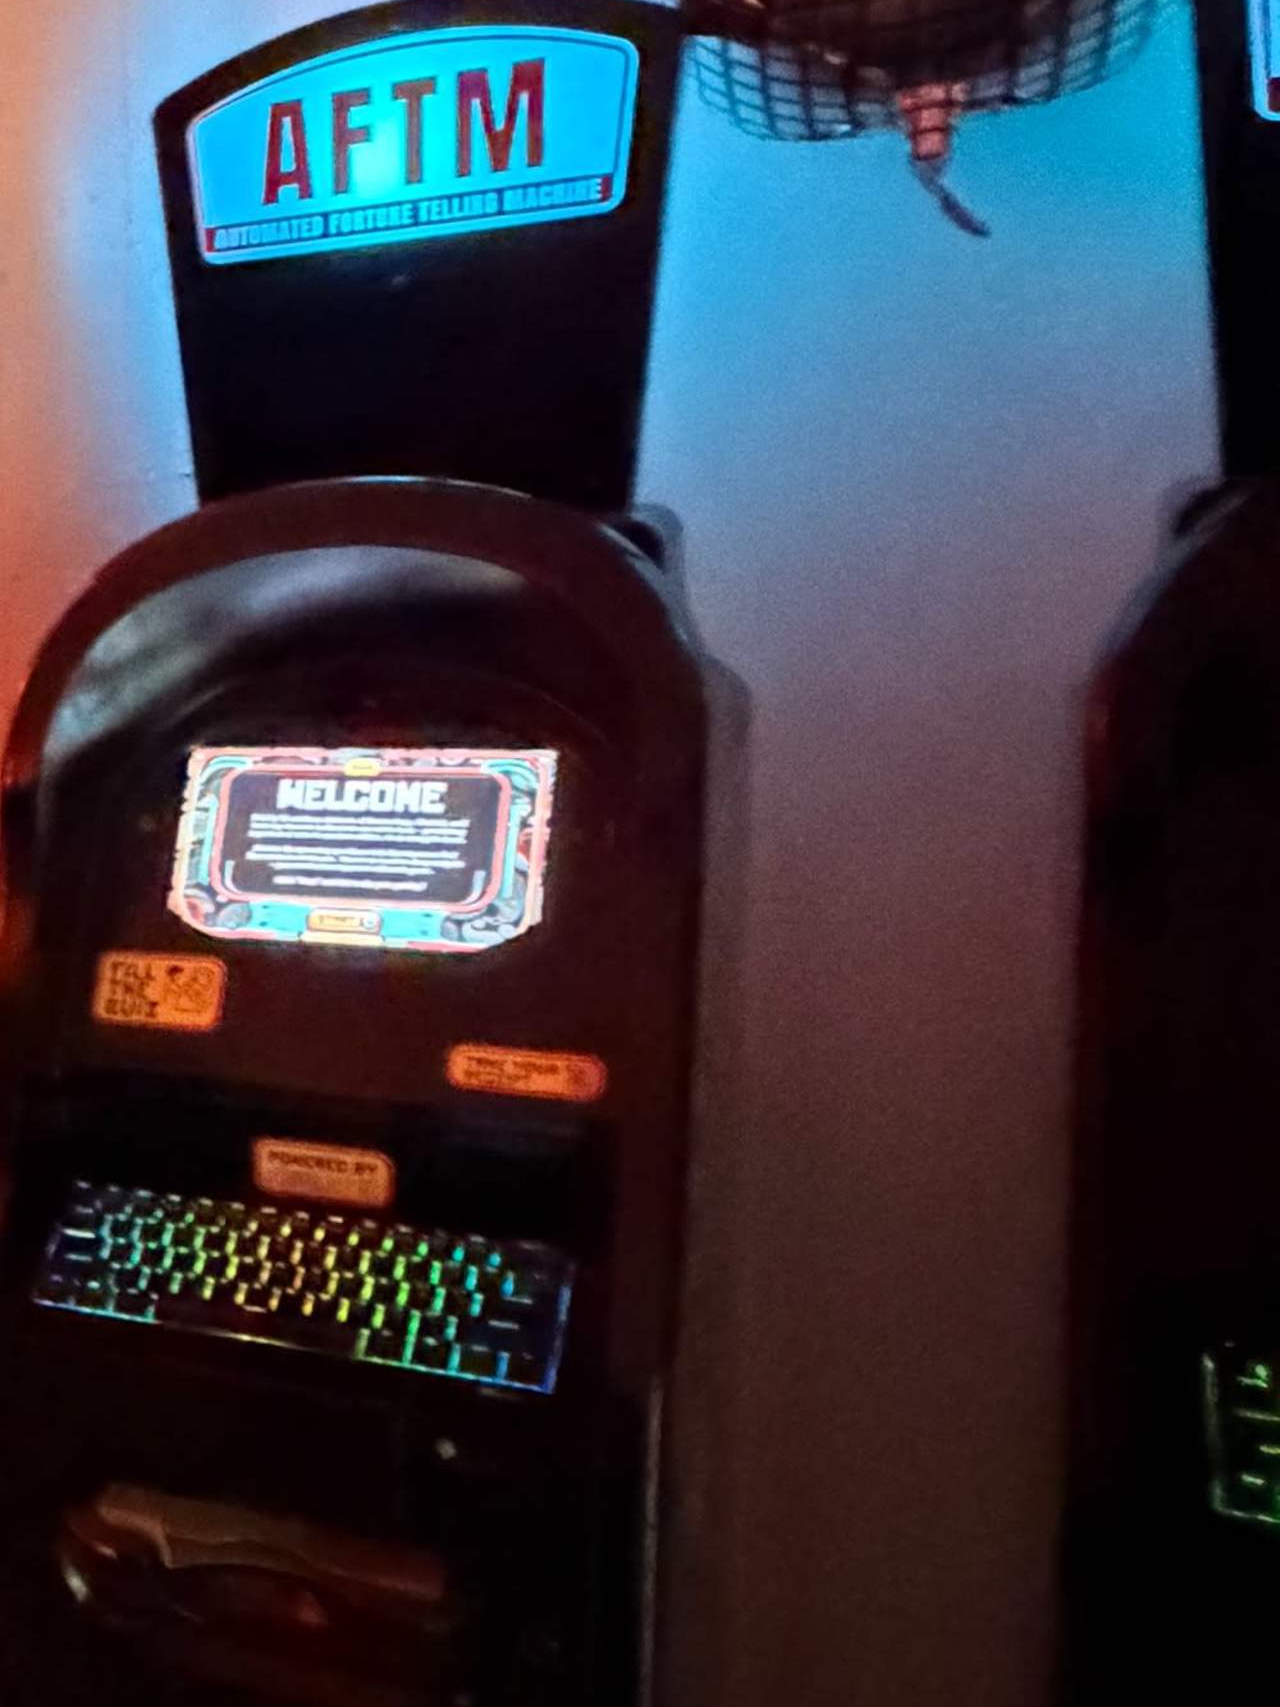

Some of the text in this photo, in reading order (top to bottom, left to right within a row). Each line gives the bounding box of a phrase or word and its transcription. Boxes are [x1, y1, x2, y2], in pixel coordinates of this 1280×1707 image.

[262, 57, 545, 206] AFTM
[214, 177, 601, 250] AUTOMATED FORTUNE TELLING MACHINE
[276, 779, 448, 813] WELCOME
